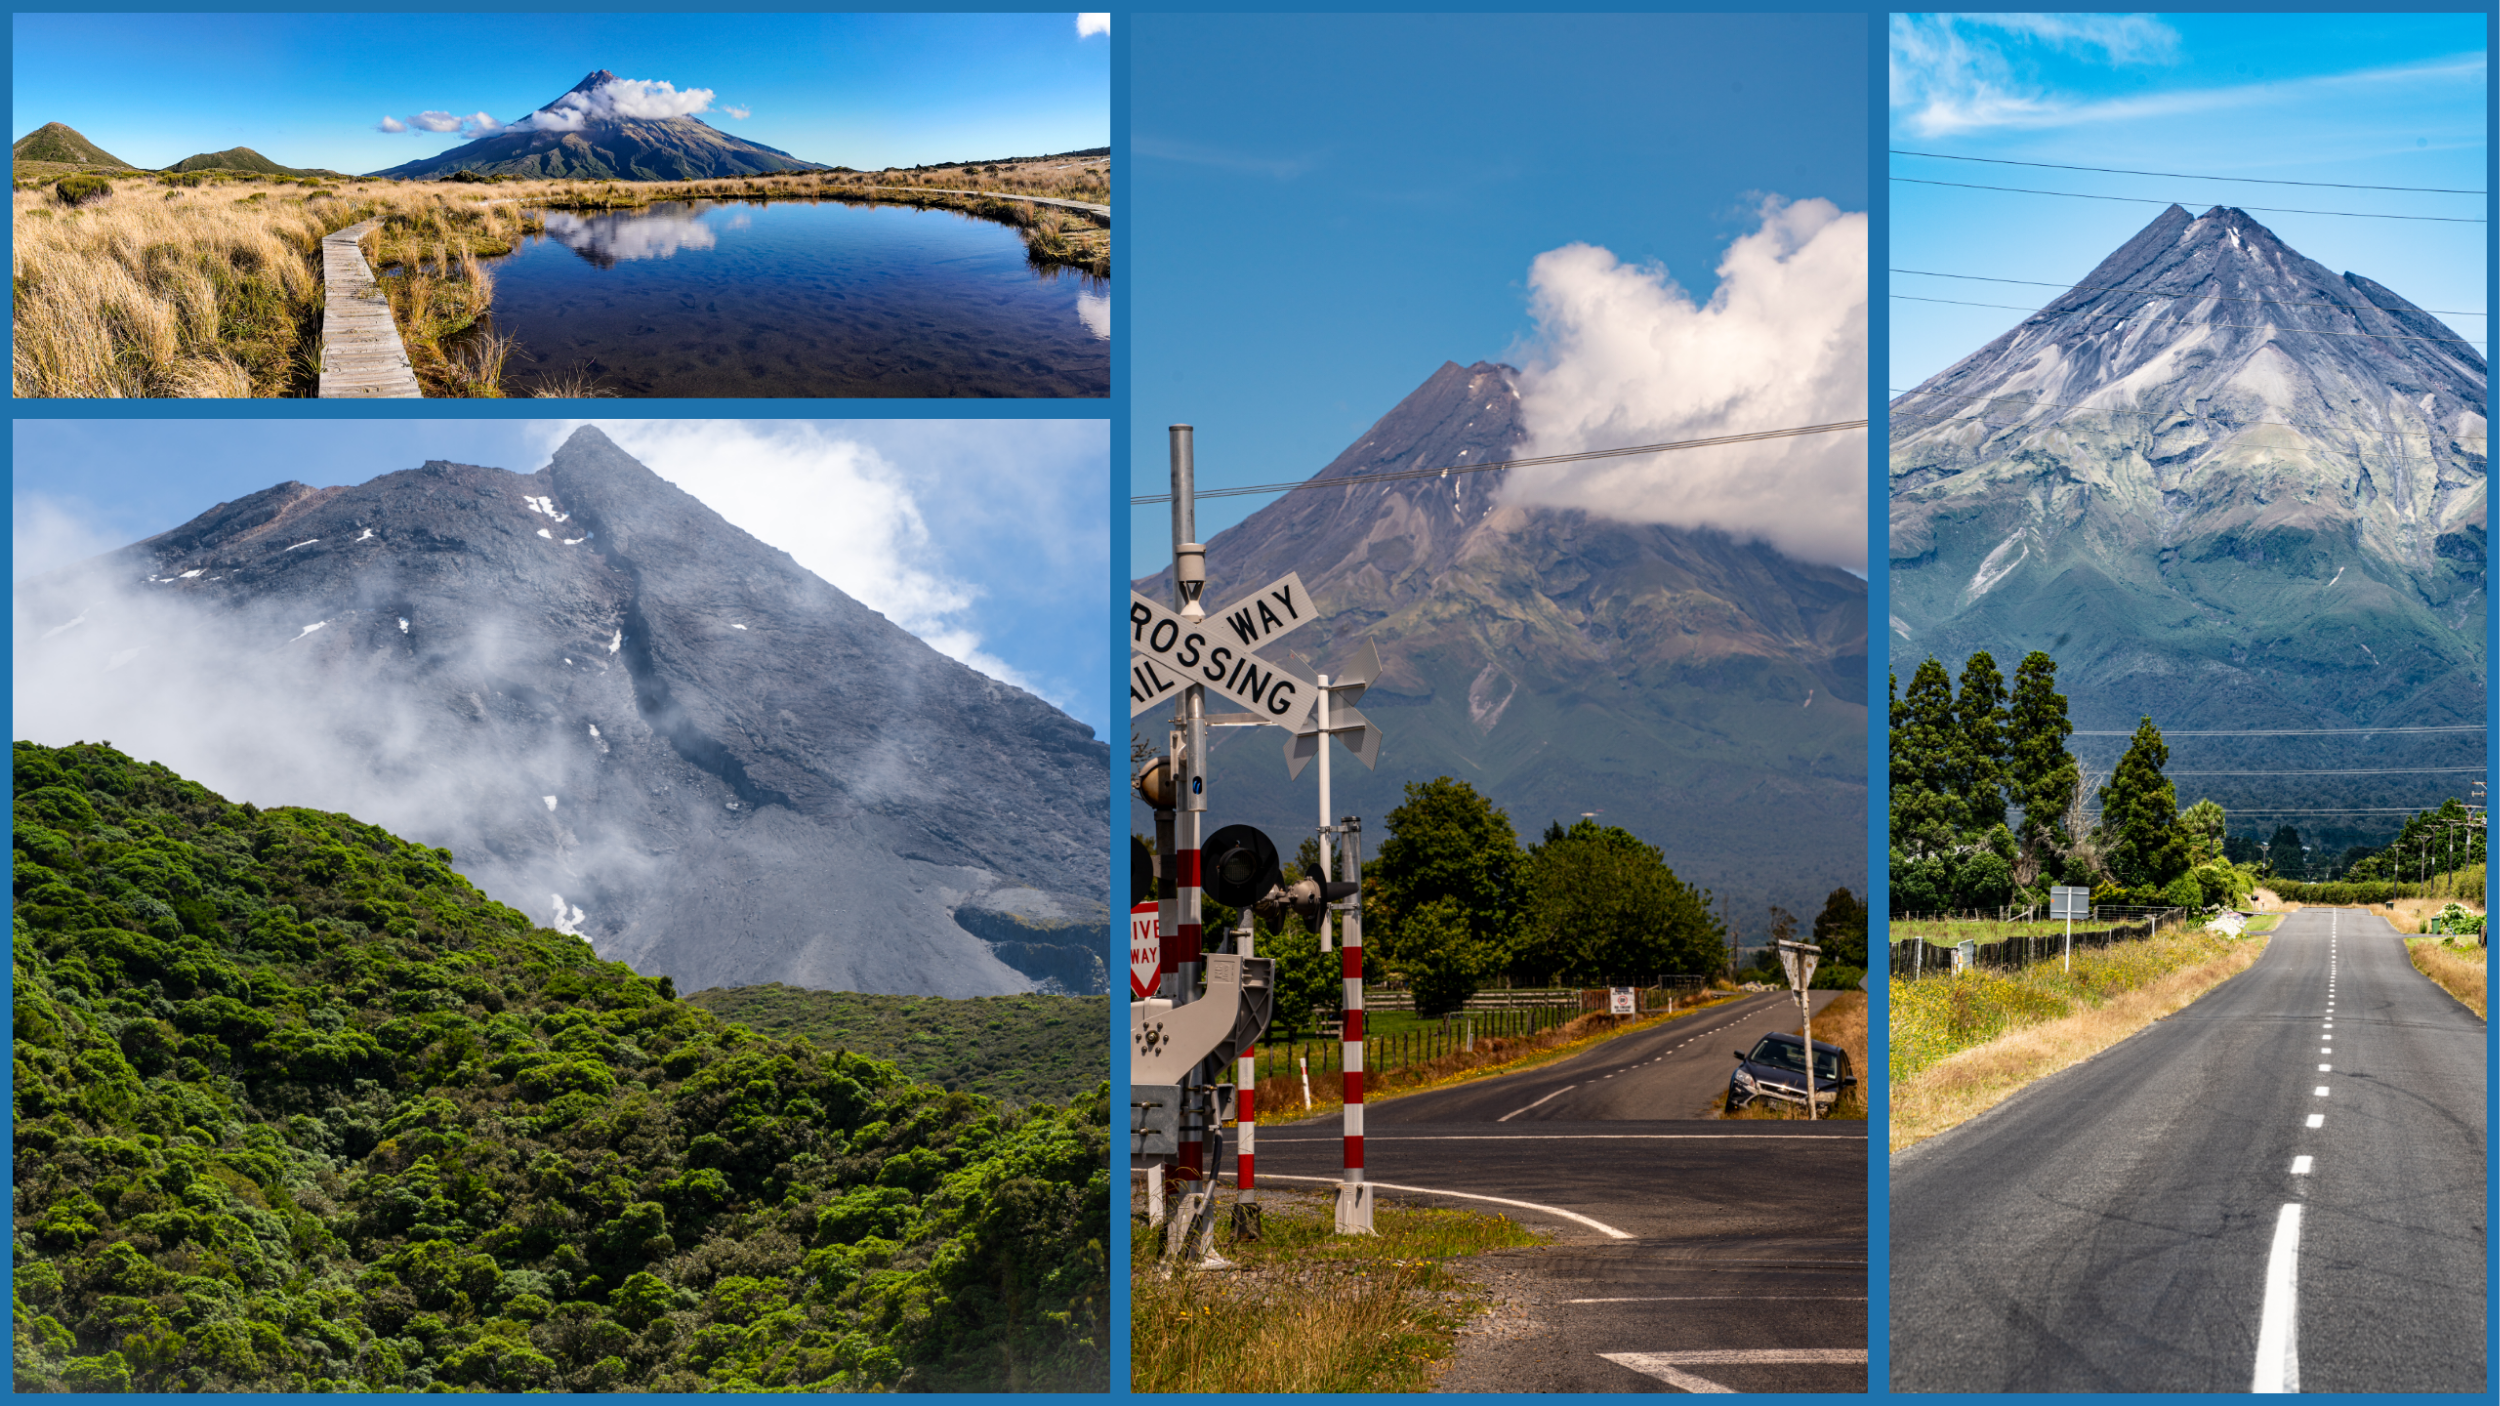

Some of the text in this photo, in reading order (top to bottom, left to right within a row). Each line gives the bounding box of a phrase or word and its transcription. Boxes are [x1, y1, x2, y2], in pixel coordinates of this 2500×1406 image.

[1226, 584, 1298, 646] WAY
[1131, 601, 1296, 715] ROSSING
[1131, 919, 1160, 940] IVE
[1131, 947, 1157, 965] WAY
